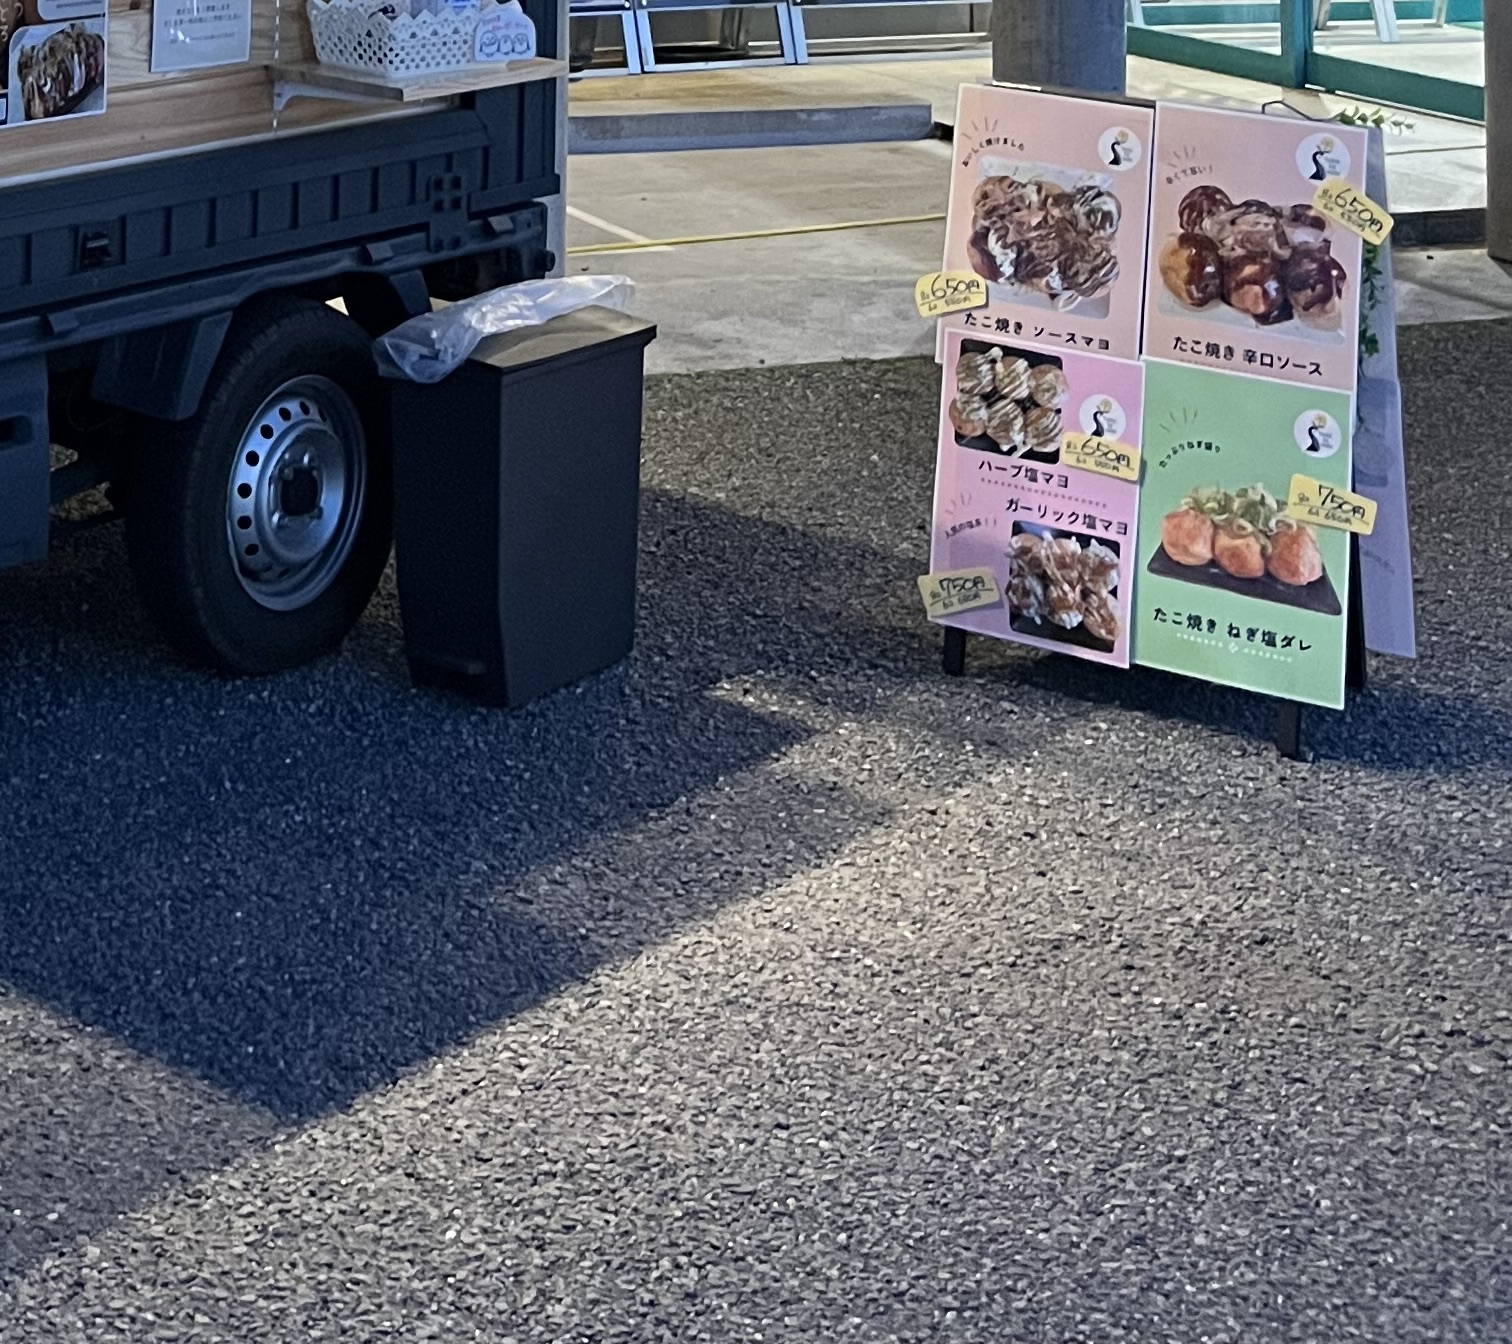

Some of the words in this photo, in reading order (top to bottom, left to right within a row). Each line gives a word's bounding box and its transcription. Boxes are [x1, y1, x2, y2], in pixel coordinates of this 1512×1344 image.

[1335, 187, 1384, 233] 650円
[930, 274, 980, 299] 650円
[964, 312, 1023, 335] たこ焼き
[1033, 326, 1110, 350] ソースマヨ
[1172, 336, 1235, 361] たこ焼き
[1242, 348, 1323, 376] 辛口ソース
[1080, 437, 1131, 468] 650円
[978, 459, 1069, 489] ハーブ塩マヨ
[1005, 497, 1128, 536] ガーリック塩マヨ
[1318, 483, 1366, 519] 750円
[938, 575, 986, 599] 750円
[1153, 607, 1217, 634] たこ焼き
[1227, 622, 1312, 652] ねぎ塩ダレ
